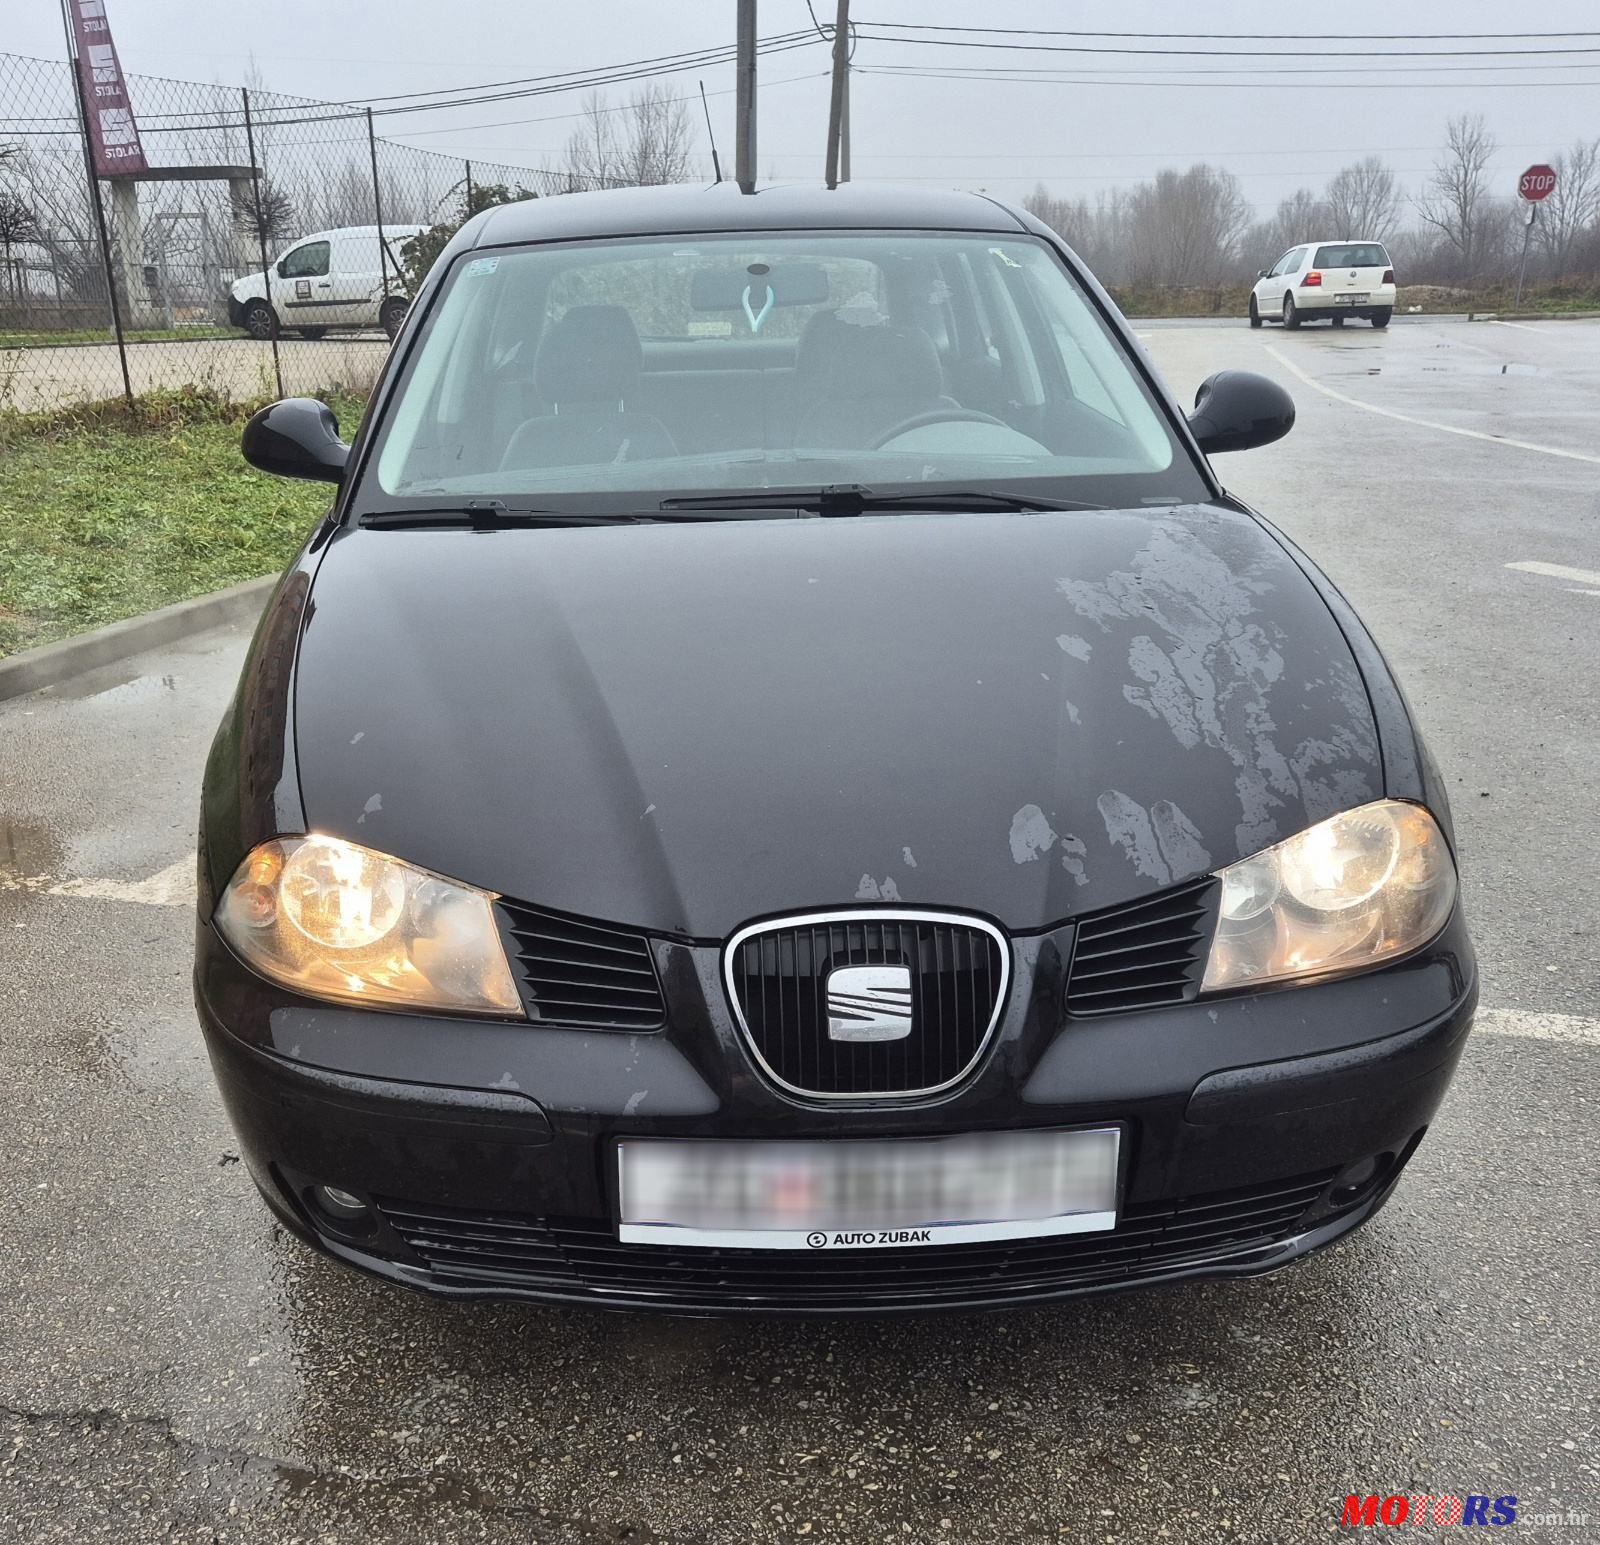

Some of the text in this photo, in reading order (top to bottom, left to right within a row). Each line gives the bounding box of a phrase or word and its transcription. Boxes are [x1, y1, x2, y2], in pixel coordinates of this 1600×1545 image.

[1521, 175, 1554, 191] STOP
[833, 1230, 932, 1245] AUTO ZUBAK
